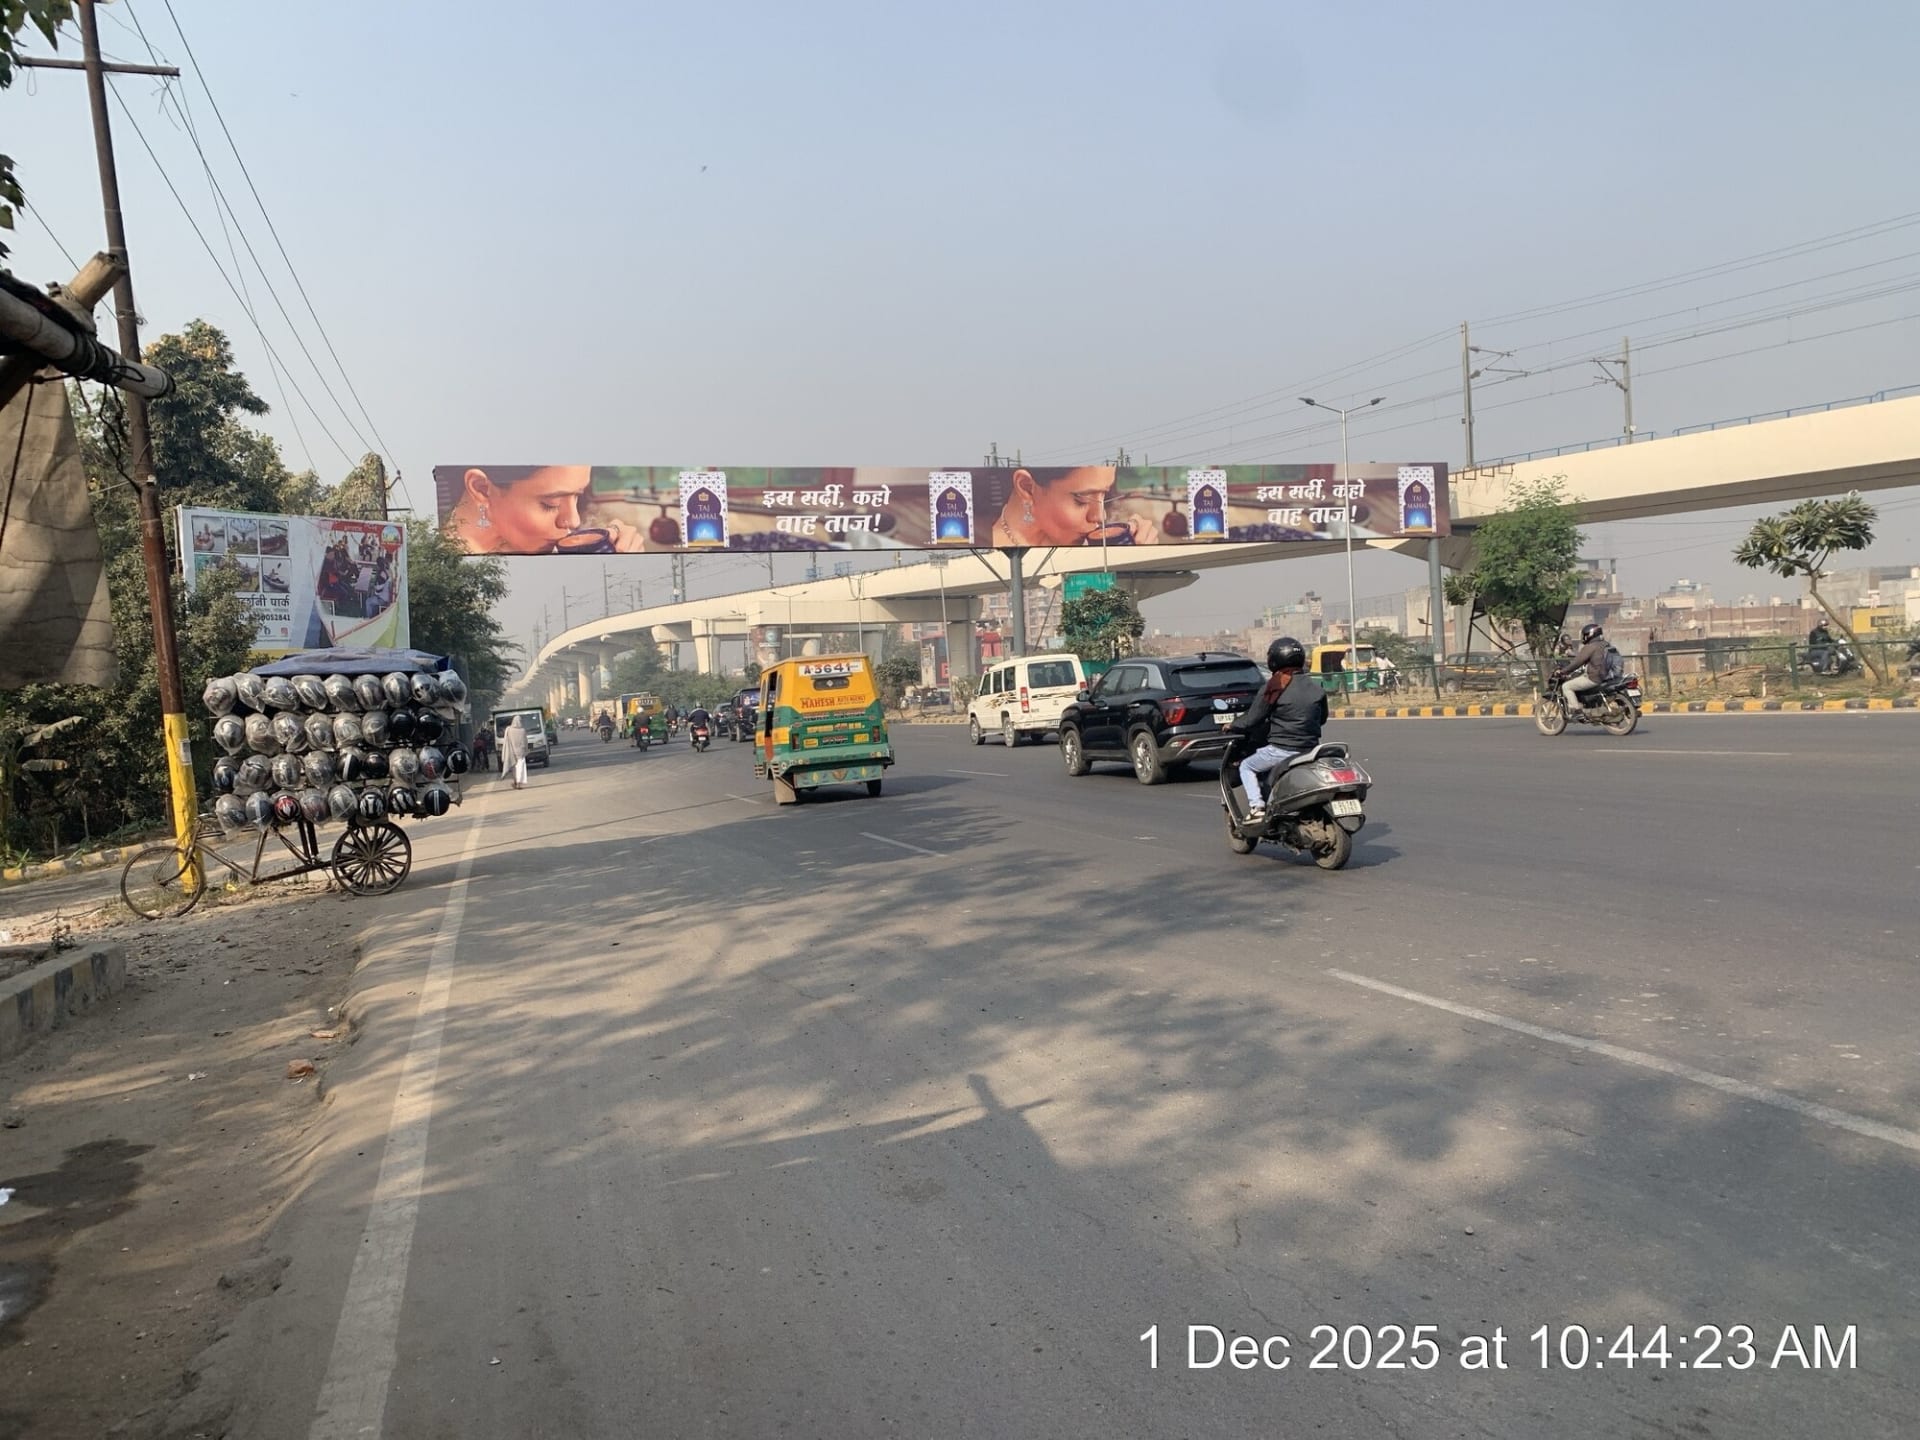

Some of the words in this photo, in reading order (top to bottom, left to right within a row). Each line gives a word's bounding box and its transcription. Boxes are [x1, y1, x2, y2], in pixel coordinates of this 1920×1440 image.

[762, 490, 795, 508] इस
[800, 484, 845, 509] सर्दी,
[852, 484, 891, 508] कहो
[1256, 485, 1285, 502] इस
[1288, 479, 1326, 501] सर्दी,
[1332, 478, 1367, 500] कहो
[691, 512, 718, 521] MAHAL
[697, 504, 711, 513] TAJ
[1268, 508, 1303, 525] वाह
[1309, 505, 1357, 524] ताज!
[776, 515, 817, 535] वाह
[824, 513, 881, 534] ताज!
[800, 696, 835, 709] MAHESH
